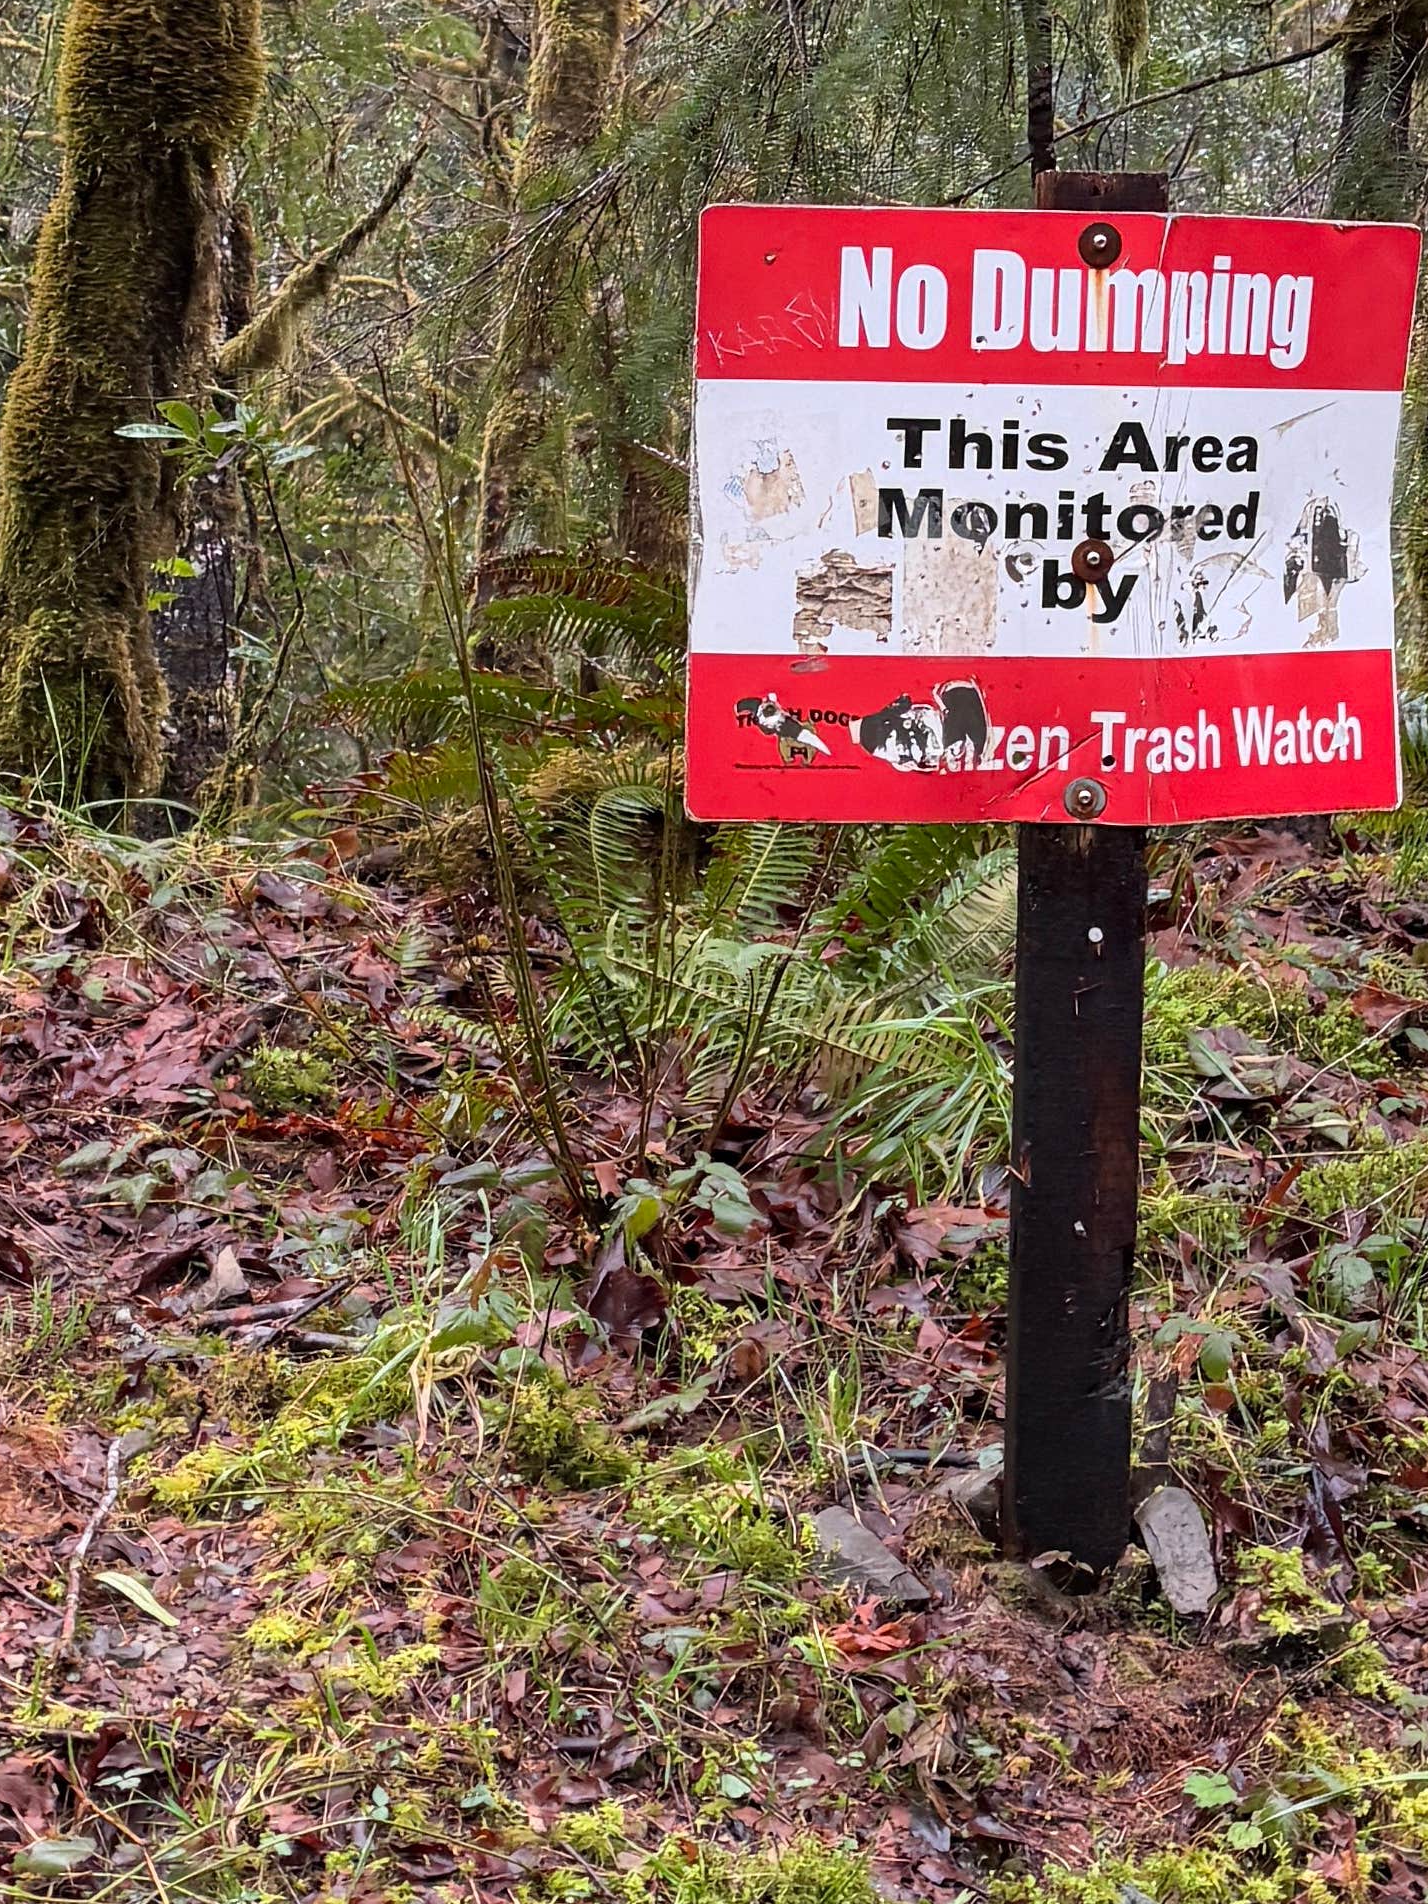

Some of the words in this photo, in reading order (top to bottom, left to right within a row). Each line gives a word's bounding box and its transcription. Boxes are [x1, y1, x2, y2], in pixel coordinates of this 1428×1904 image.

[838, 246, 948, 350] No
[971, 248, 1314, 370] Dumping
[887, 418, 1070, 470] This
[1098, 421, 1259, 473] Area
[877, 487, 1261, 542] Monitored
[1041, 559, 1139, 624] by
[809, 708, 861, 727] DOG
[1090, 708, 1221, 774] Trash
[1232, 701, 1363, 767] Watch
